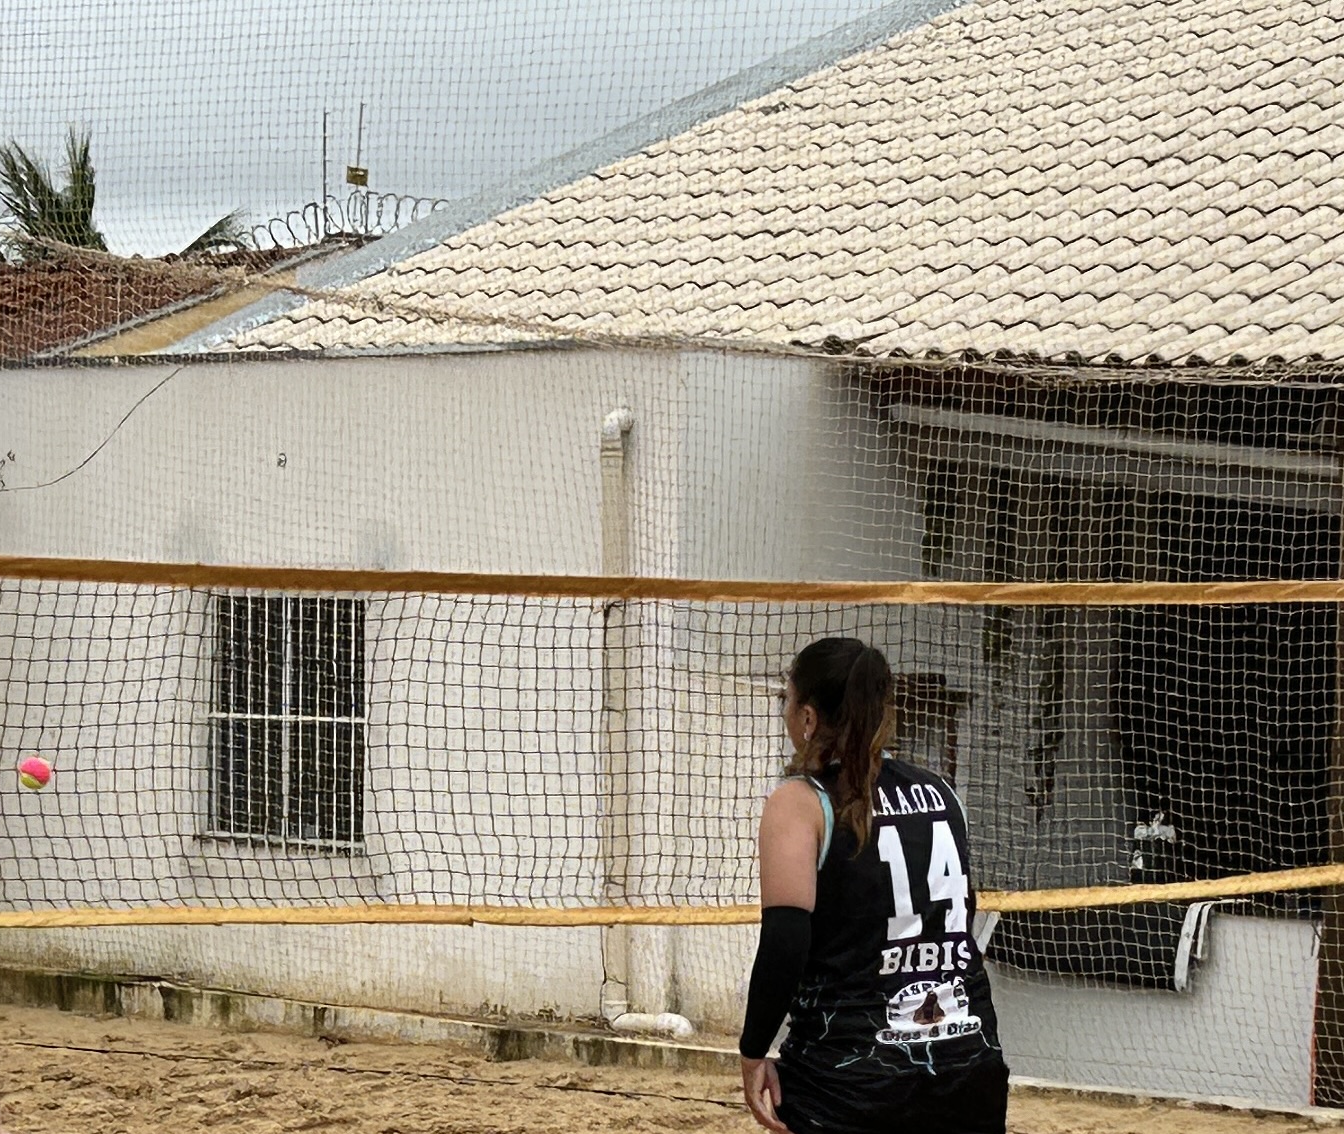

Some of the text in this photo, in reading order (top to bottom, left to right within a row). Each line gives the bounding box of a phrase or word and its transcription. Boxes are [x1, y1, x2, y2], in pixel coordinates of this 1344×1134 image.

[872, 783, 946, 817] AAOD
[877, 820, 968, 941] 14
[878, 940, 972, 975] BIBIS
